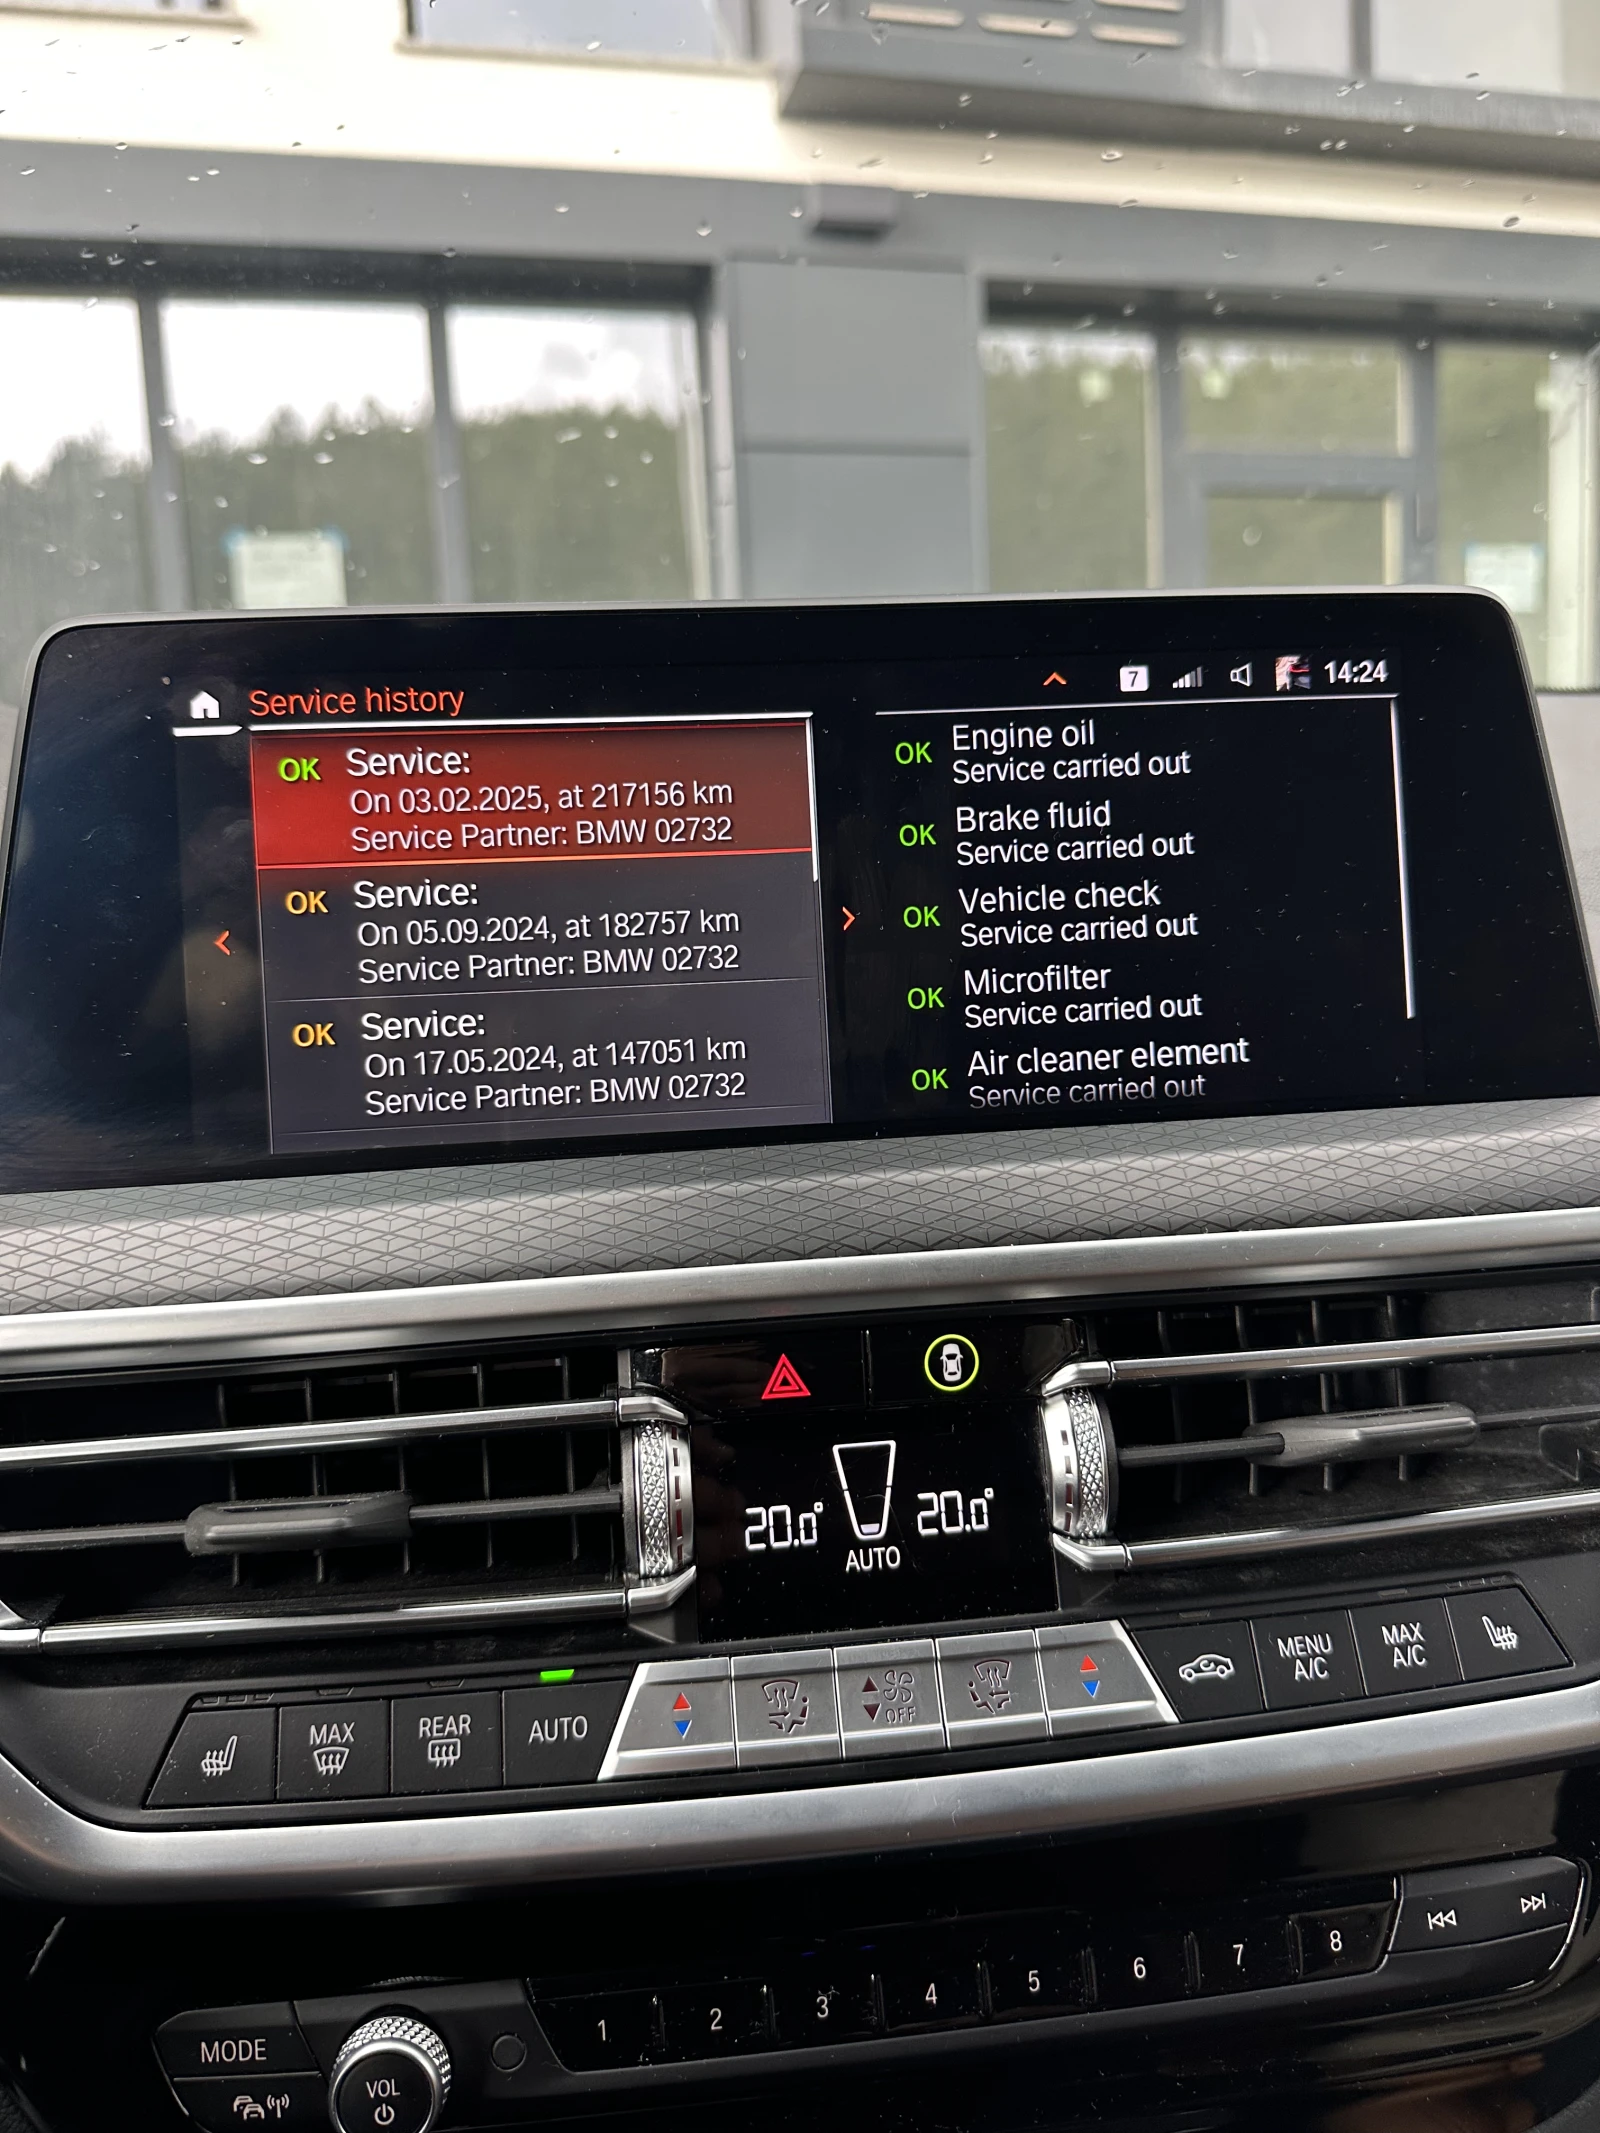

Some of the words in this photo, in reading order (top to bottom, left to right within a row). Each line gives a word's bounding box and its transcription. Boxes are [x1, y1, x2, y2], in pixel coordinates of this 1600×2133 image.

[1128, 670, 1138, 688] 7
[1324, 660, 1389, 684] 14:24
[249, 691, 357, 717] Service
[365, 687, 465, 715] history
[952, 723, 1054, 754] Engine
[1062, 720, 1096, 747] oil
[346, 748, 471, 777] Service:
[894, 742, 932, 764] OK
[278, 758, 321, 782] OK
[952, 758, 1045, 784] Service
[1053, 754, 1140, 780] carried
[1148, 751, 1191, 774] out
[350, 790, 391, 815] On
[398, 785, 550, 816] 03.02.2025,
[558, 784, 583, 808] at
[591, 782, 685, 809] 217156
[692, 780, 733, 805] km
[956, 804, 1040, 832] Brake
[1048, 800, 1112, 829] fluid
[351, 825, 453, 852] Service
[461, 821, 568, 848] Partner:
[576, 819, 647, 845] BMW
[654, 817, 733, 843] 02732
[899, 824, 936, 846] OK
[956, 839, 1049, 866] Service
[1056, 836, 1144, 861] carried
[1152, 832, 1195, 856] out
[285, 890, 328, 915] OK
[353, 880, 478, 909] Service:
[958, 886, 1066, 914] Vehicle
[1074, 880, 1161, 908] check
[357, 922, 398, 946] On
[406, 917, 557, 945] 05.09.2024,
[565, 913, 591, 939] at
[598, 910, 691, 938] 182757
[699, 909, 740, 934] km
[903, 906, 940, 928] OK
[960, 921, 1053, 948] Service
[1060, 916, 1148, 942] carried
[1156, 914, 1198, 937] out
[358, 956, 460, 984] Service
[469, 952, 575, 979] Partner:
[583, 950, 654, 975] BMW
[661, 945, 740, 971] 02732
[964, 966, 1111, 996] Microfilter
[907, 987, 944, 1009] OK
[964, 1002, 1057, 1029] Service
[1064, 998, 1152, 1024] carried
[1160, 996, 1202, 1018] out
[292, 1022, 335, 1047] OK
[361, 1011, 485, 1040] Service:
[364, 1053, 405, 1078] On
[414, 1047, 564, 1075] 17.05.2024,
[572, 1043, 598, 1069] at
[605, 1040, 697, 1067] 147051
[706, 1037, 747, 1063] km
[968, 1048, 1008, 1077] Air
[1016, 1044, 1124, 1074] cleaner
[1130, 1038, 1250, 1068] element
[911, 1068, 949, 1090] OK
[365, 1088, 468, 1115] Service
[475, 1083, 583, 1110] Partner:
[590, 1079, 661, 1104] BMW
[668, 1073, 746, 1100] 02732
[969, 1084, 1061, 1110] Service
[1068, 1079, 1156, 1104] carried
[1163, 1076, 1206, 1098] out
[845, 1547, 901, 1572] AUTO
[1381, 1621, 1425, 1646] MAX
[1277, 1632, 1332, 1661] MENU
[1392, 1644, 1428, 1668] A/C
[1293, 1656, 1329, 1681] A/C
[418, 1714, 471, 1739] REAR
[884, 1704, 918, 1726] OFF
[309, 1722, 355, 1746] MAX
[528, 1715, 589, 1743] AUTO
[1329, 1929, 1343, 1952] 8
[1232, 1943, 1246, 1966] 7
[1132, 1956, 1147, 1979] 6
[924, 1982, 938, 2005] 4
[1028, 1969, 1041, 1993] 5
[709, 2007, 723, 2030] 2
[816, 1994, 830, 2019] 3
[597, 2018, 609, 2042] 1
[200, 2037, 268, 2064] MODE
[365, 2078, 401, 2098] VOL
